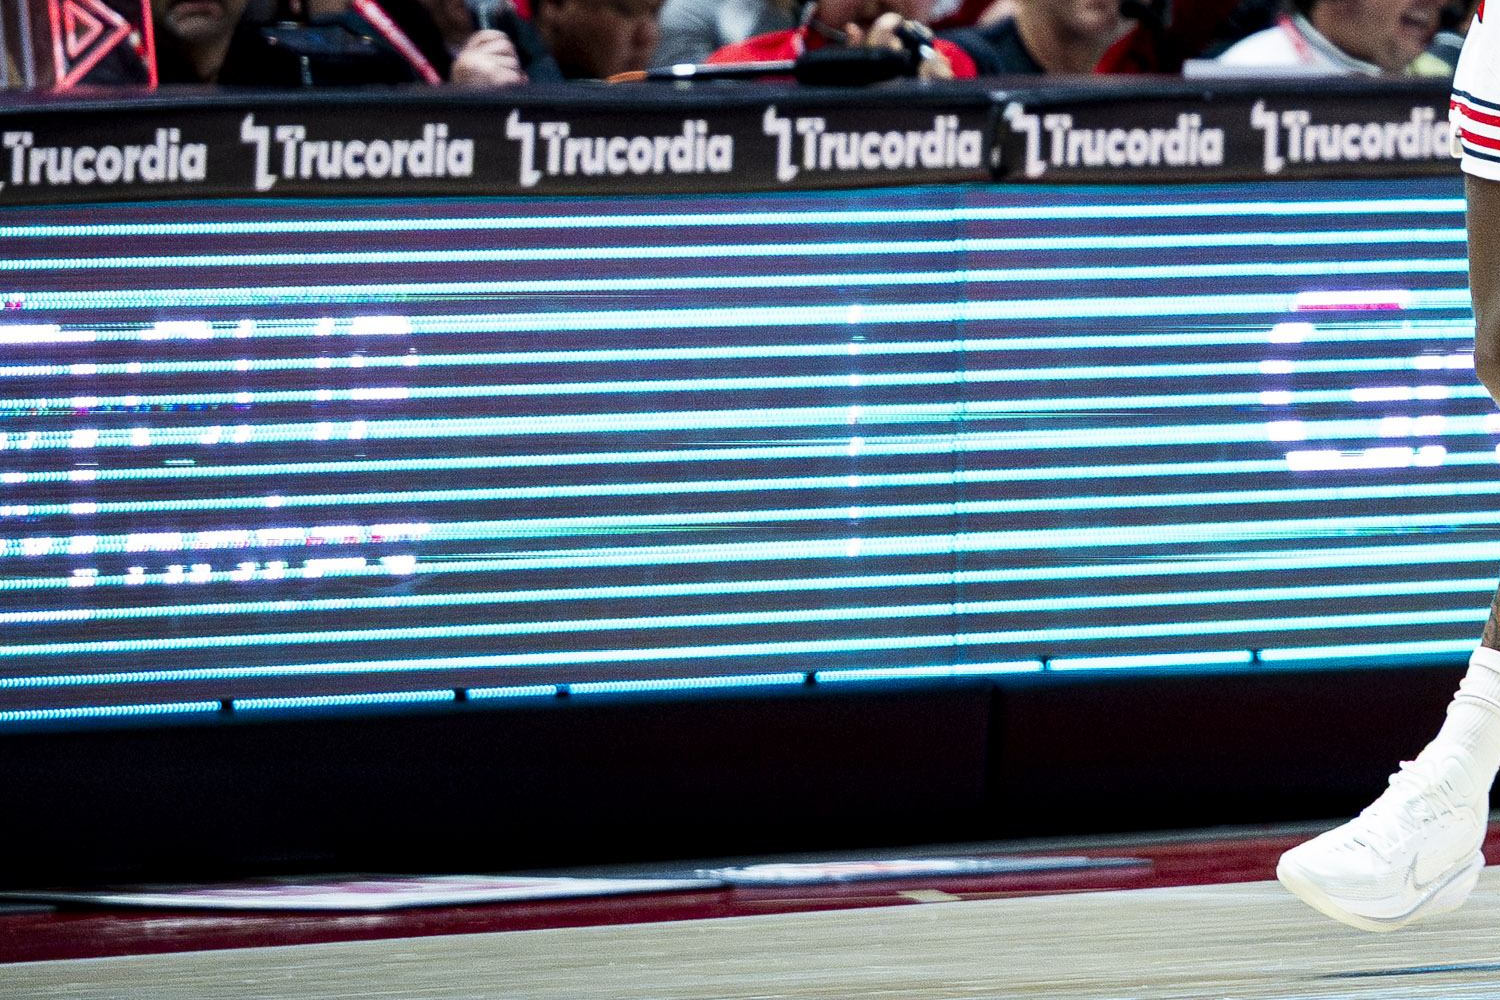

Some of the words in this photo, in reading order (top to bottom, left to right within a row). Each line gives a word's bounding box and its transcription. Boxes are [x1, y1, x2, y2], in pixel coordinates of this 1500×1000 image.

[3, 128, 207, 185] Trucordia
[275, 123, 474, 179] Trucordia
[539, 120, 733, 175] Trucordia
[795, 115, 982, 170] Trucordia
[1044, 112, 1224, 168] Trucordia
[1281, 106, 1451, 163] Trucordia
